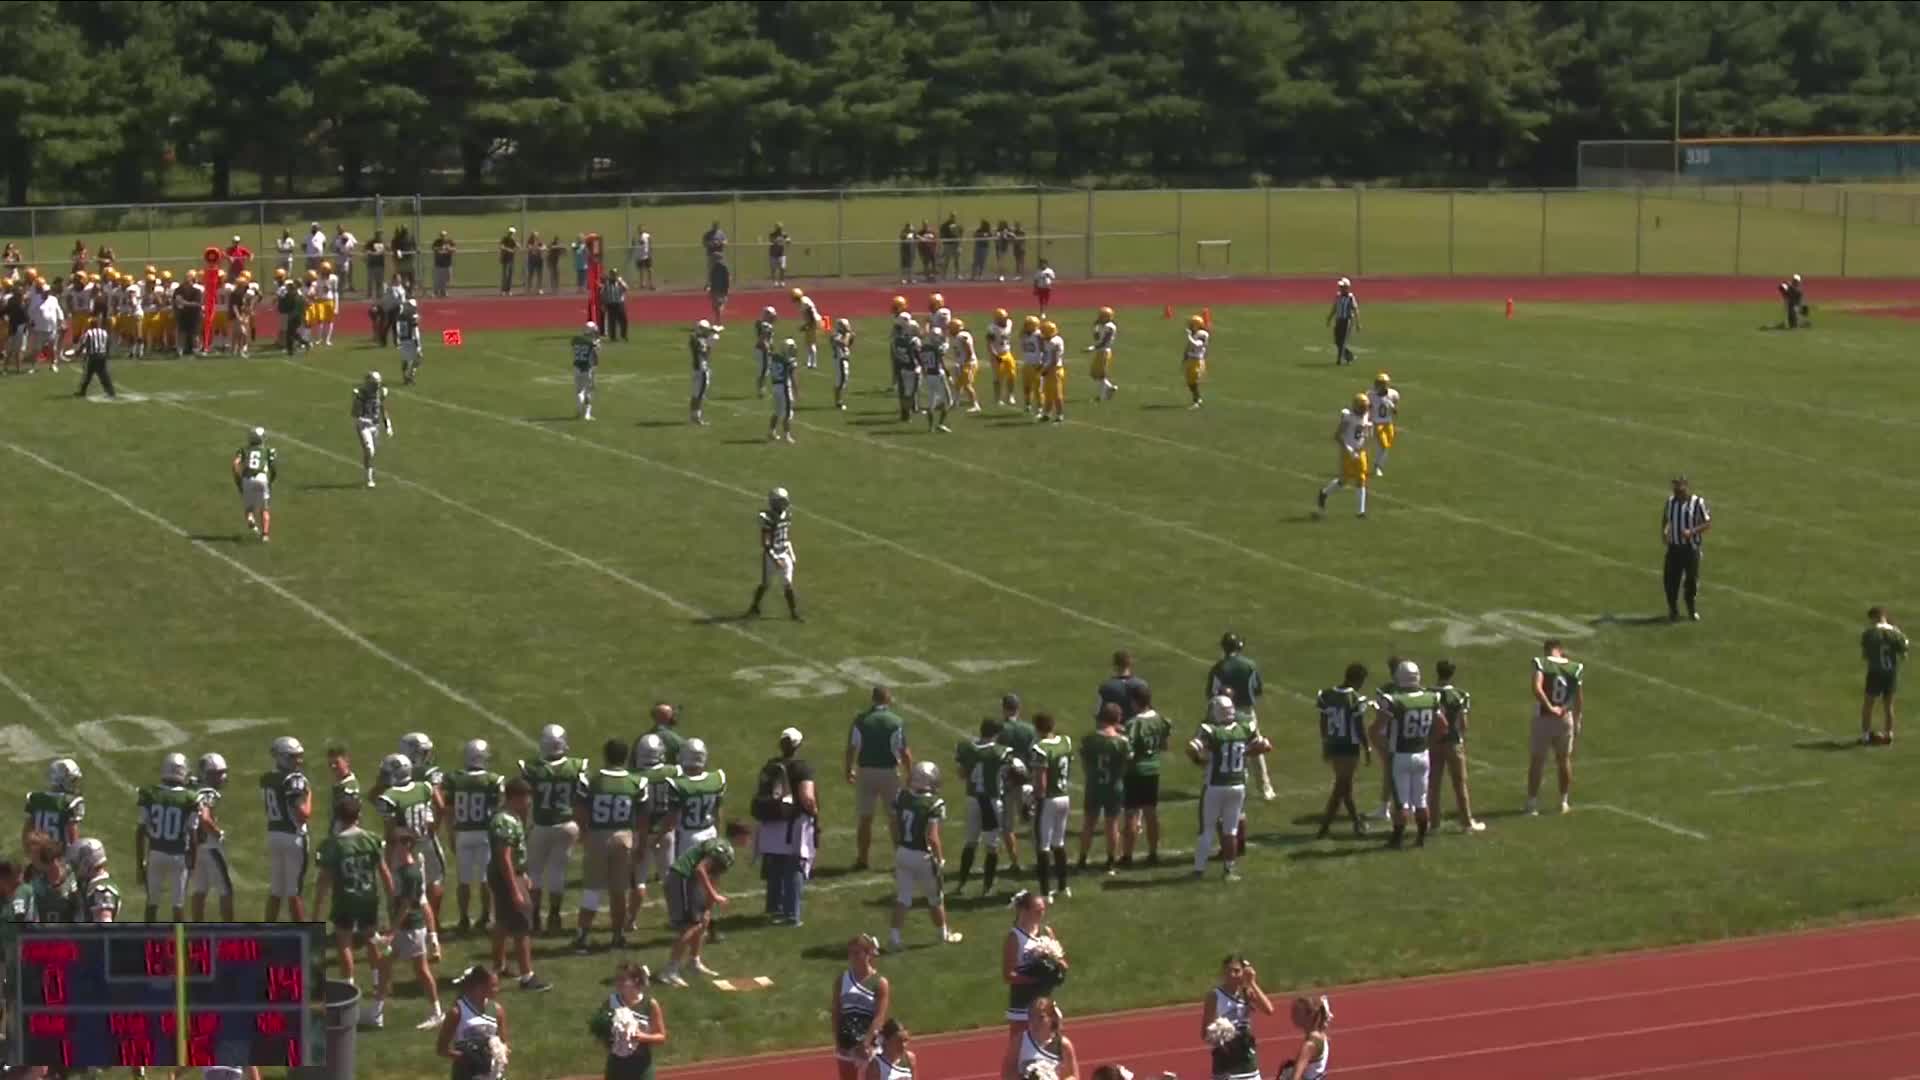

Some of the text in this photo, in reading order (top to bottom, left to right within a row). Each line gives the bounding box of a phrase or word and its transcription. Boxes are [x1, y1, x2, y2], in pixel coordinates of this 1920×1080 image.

[249, 450, 262, 469] 6
[970, 761, 985, 793] 4
[454, 792, 486, 823] 88
[538, 783, 571, 814] 73
[150, 804, 182, 841] 30
[902, 809, 914, 842] 7
